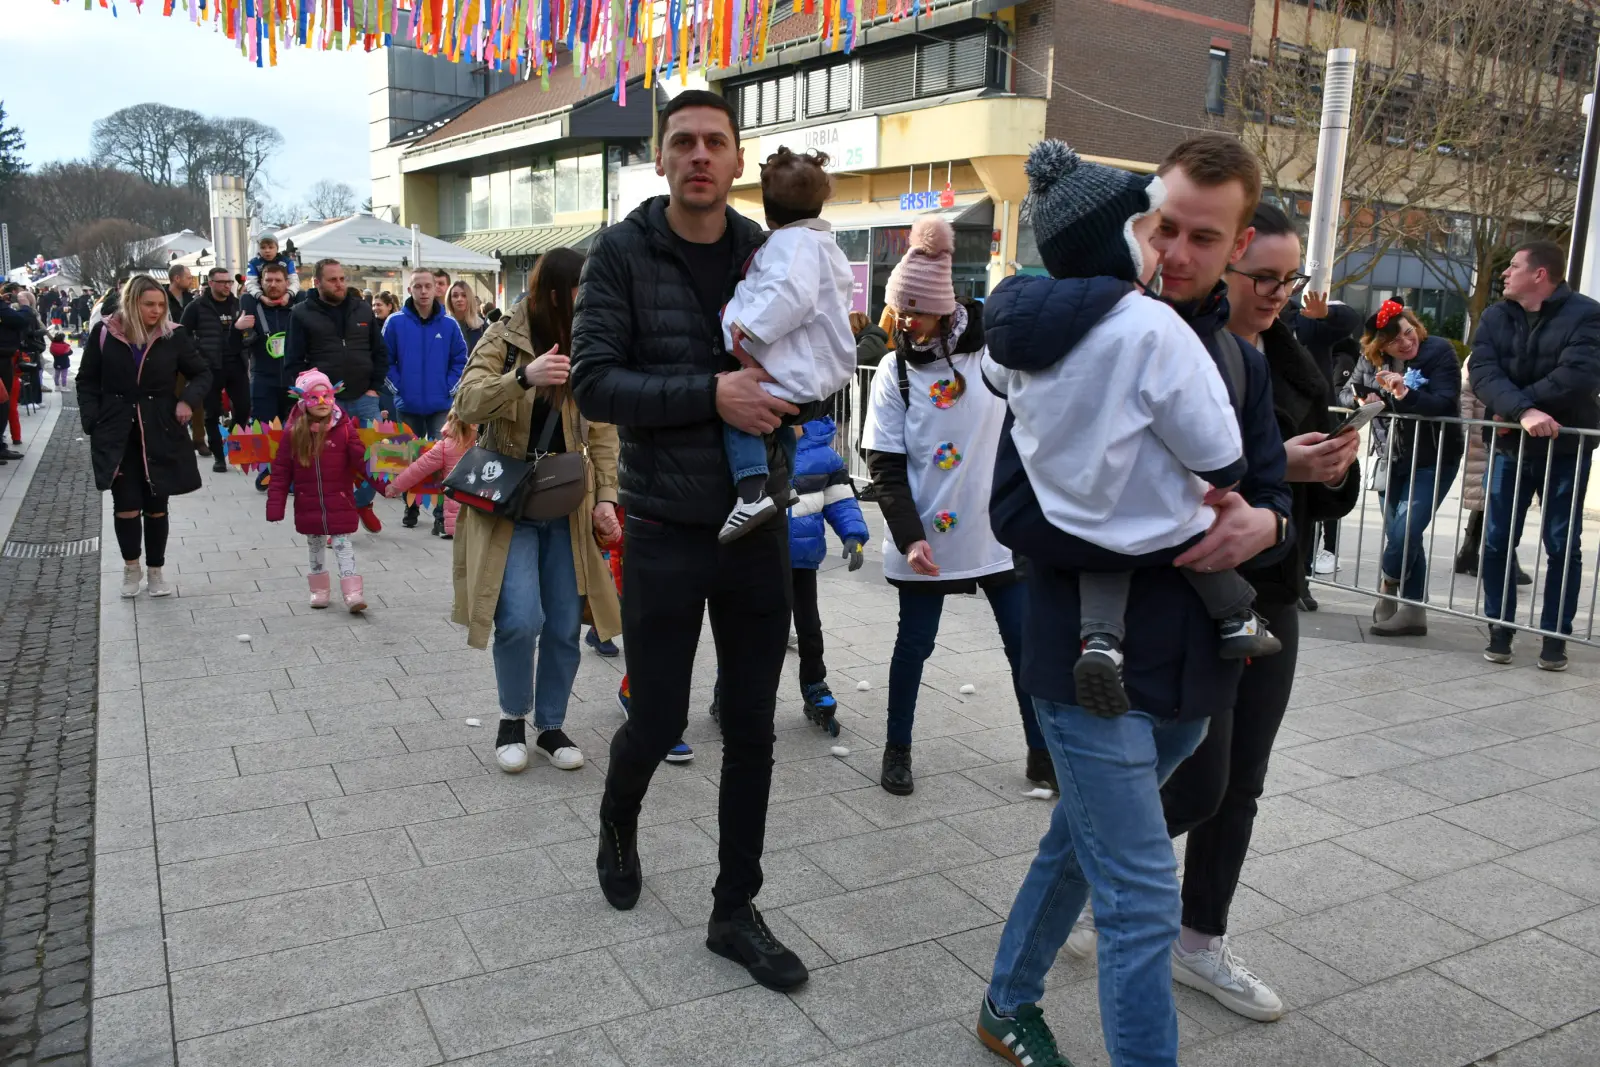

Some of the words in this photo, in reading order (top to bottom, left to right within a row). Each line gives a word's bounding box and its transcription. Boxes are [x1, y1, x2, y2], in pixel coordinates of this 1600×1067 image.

[805, 128, 839, 147] URBIA
[846, 147, 863, 166] 25
[900, 191, 939, 210] ERSTE
